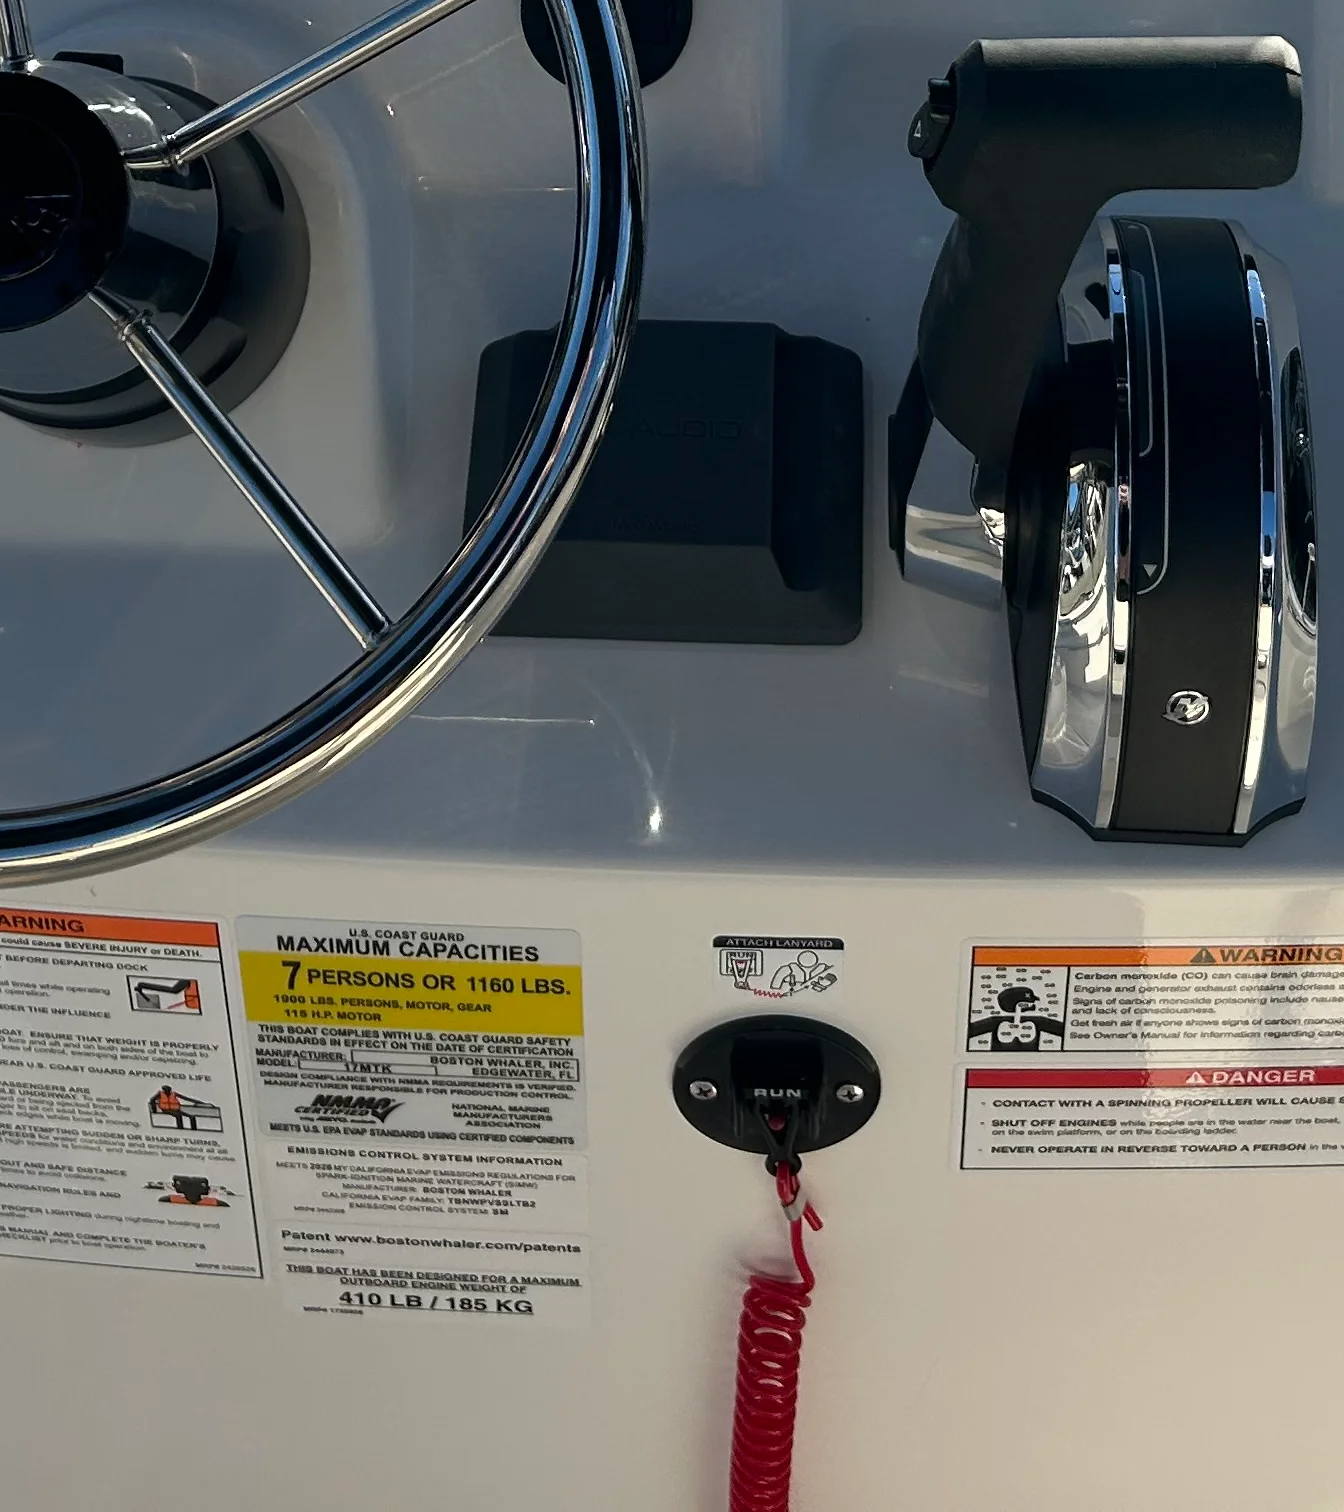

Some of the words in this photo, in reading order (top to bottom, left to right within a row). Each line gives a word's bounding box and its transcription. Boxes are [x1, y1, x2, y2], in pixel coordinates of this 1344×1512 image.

[375, 929, 418, 940] COAST
[420, 931, 465, 942] GUARD
[725, 937, 773, 947] ATTACH
[776, 938, 833, 948] LANYARD
[0, 934, 30, 944] could
[32, 937, 61, 946] cause
[64, 939, 106, 950] SEVERE
[110, 943, 147, 953] INJURY
[276, 935, 390, 955] MAXIMUM
[399, 940, 540, 962] CAPACITIES
[6, 954, 49, 963] BEFORE
[52, 957, 114, 968] DEPARTING
[116, 963, 148, 971] DOCK
[1220, 947, 1343, 963] WARNING
[281, 960, 302, 991] 7
[307, 968, 415, 989] PERSONS
[422, 973, 456, 991] OR
[467, 976, 515, 994] 1160
[521, 977, 572, 996] LBS.
[1075, 972, 1118, 981] Carbon
[1121, 972, 1178, 980] monoxide
[1181, 971, 1209, 981] (CO)
[1270, 970, 1298, 978] brain
[309, 996, 337, 1006] LBS.
[340, 997, 404, 1010] PERSONS,
[406, 1000, 454, 1012] MOTOR,
[457, 1002, 492, 1013] GEAR
[337, 1011, 382, 1022] MOTOR
[258, 1024, 284, 1033] THIS
[288, 1025, 318, 1035] BOAT
[320, 1027, 380, 1038] COMPLIES
[382, 1030, 412, 1039] WITH
[439, 1033, 479, 1042] COAST
[482, 1035, 523, 1044] GUARD
[526, 1037, 571, 1046] SAFETY
[257, 1034, 327, 1045] STANDARDS
[330, 1037, 342, 1046] IN
[344, 1038, 386, 1048] EFFECT
[390, 1040, 408, 1049] ON
[410, 1041, 433, 1050] THE
[436, 1042, 466, 1051] DATE
[468, 1044, 484, 1052] OF
[487, 1045, 574, 1056] CERTIFICATION
[255, 1048, 346, 1061] MANUFACTURER:
[430, 1056, 483, 1067] BOSTON
[487, 1058, 545, 1069] WHALER,
[549, 1060, 575, 1070] INC.
[256, 1057, 296, 1067] MODEL:
[344, 1063, 392, 1074] 17MTK
[472, 1067, 555, 1079] EDGEWATER,
[559, 1070, 575, 1080] FL
[1211, 1069, 1316, 1084] DANGER
[754, 1088, 801, 1098] RUN
[452, 1103, 505, 1112] NATIONAL
[508, 1105, 550, 1113] MARINE
[992, 1099, 1055, 1108] CONTACT
[1058, 1099, 1092, 1107] WITH
[1095, 1099, 1105, 1107] A
[1108, 1098, 1172, 1107] SPINNING
[1175, 1097, 1253, 1106] PROPELLER
[1255, 1097, 1288, 1106] WILL
[1291, 1095, 1336, 1105] CAUSE
[294, 1105, 370, 1116] CERTIFIED
[453, 1111, 553, 1122] MANUFACTURERS
[465, 1120, 541, 1129] ASSOCIATION
[991, 1119, 1027, 1127] SHUT
[1030, 1119, 1056, 1127] OFF
[1059, 1118, 1117, 1127] ENGINES
[287, 1145, 356, 1157] EMISSIONS
[359, 1149, 419, 1160] CONTROL
[422, 1153, 473, 1163] SYSTEM
[476, 1155, 563, 1166] INFORMATION
[991, 1145, 1035, 1154] NEVER
[1037, 1145, 1098, 1154] OPERATE
[1101, 1145, 1114, 1153] IN
[1117, 1144, 1177, 1153] REVERSE
[1180, 1144, 1237, 1153] TOWARD
[1240, 1144, 1249, 1152] A
[1253, 1143, 1306, 1152] PERSON
[281, 1229, 331, 1242] Patent
[286, 1264, 313, 1274] THIS
[316, 1265, 349, 1275] BOAT
[352, 1267, 377, 1277] HAS
[380, 1269, 414, 1279] BEEN
[416, 1271, 478, 1282] DESIGNED
[481, 1274, 507, 1283] FOR
[510, 1276, 519, 1284] A
[340, 1276, 408, 1288] OUTBOARD
[411, 1280, 456, 1290] ENGINE
[459, 1283, 507, 1293] WEIGHT
[510, 1285, 527, 1294] OF
[339, 1291, 381, 1306] 410
[390, 1293, 422, 1307] LB
[430, 1295, 439, 1309] /
[446, 1296, 487, 1311] 185
[495, 1299, 533, 1313] KG
